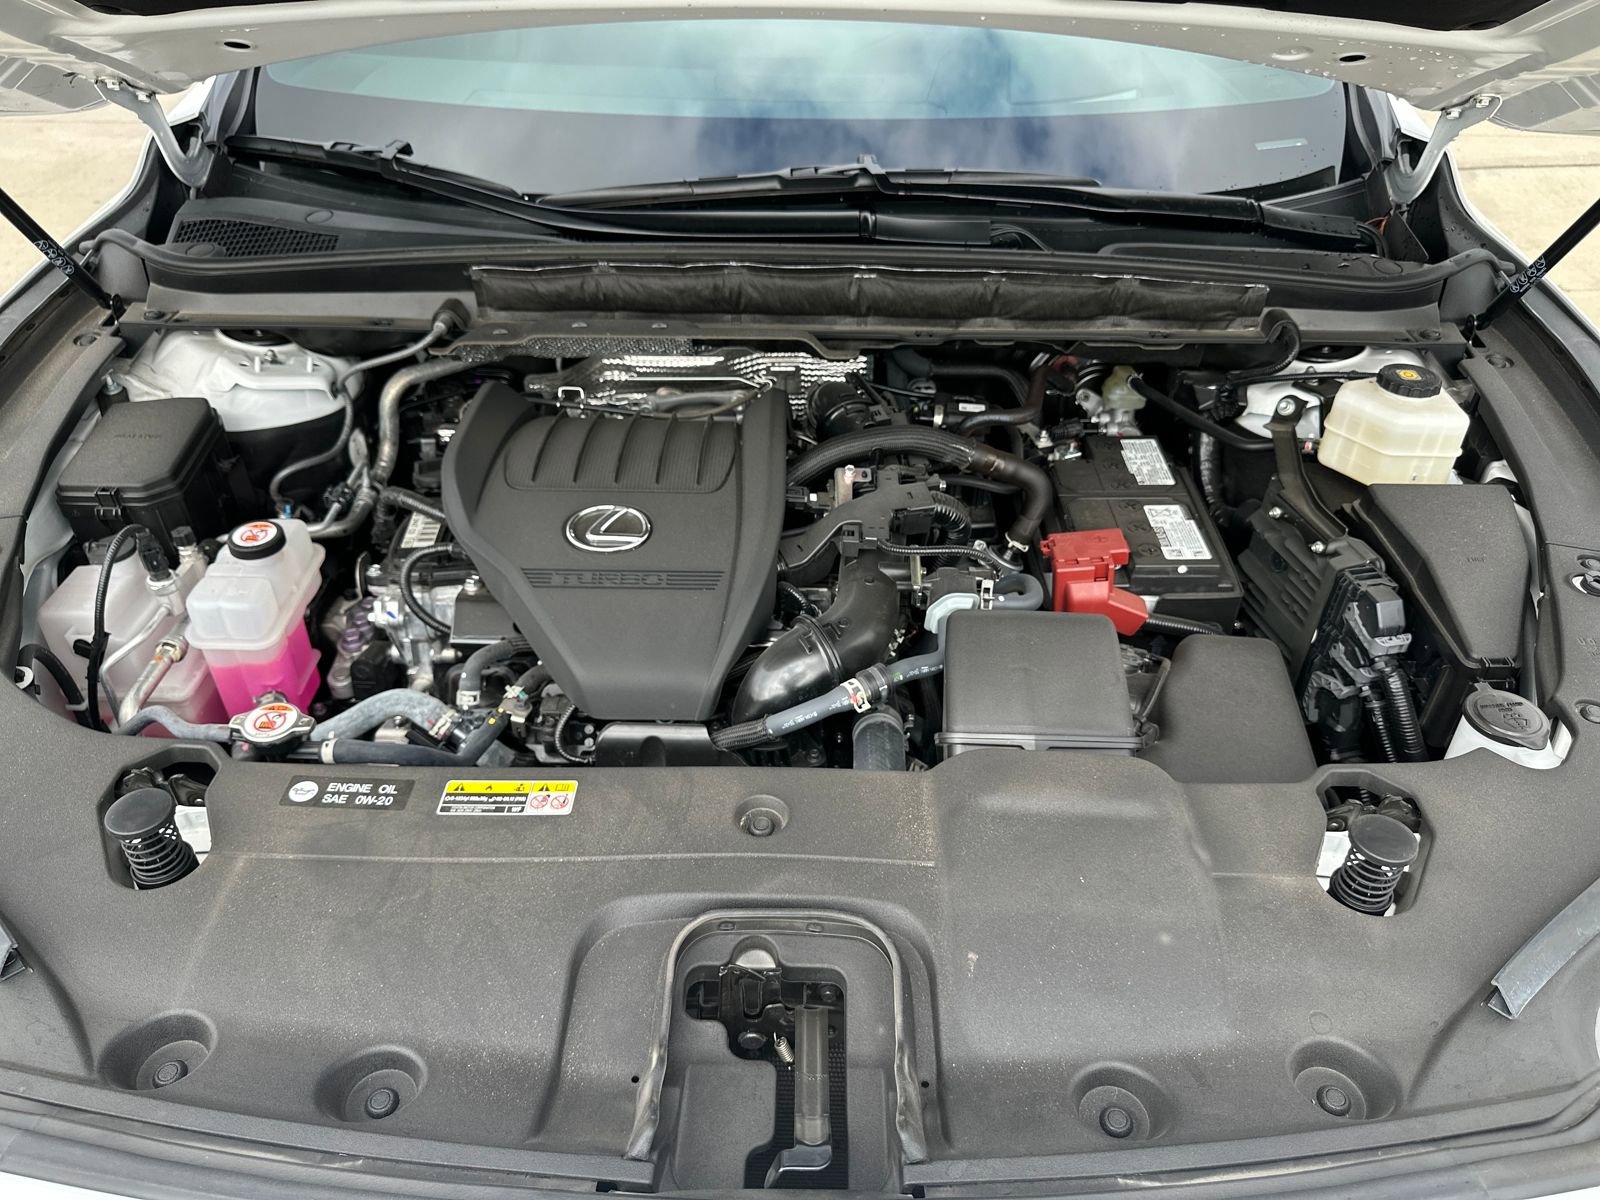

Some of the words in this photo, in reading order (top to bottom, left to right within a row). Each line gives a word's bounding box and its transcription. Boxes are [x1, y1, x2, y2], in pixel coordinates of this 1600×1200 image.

[556, 572, 664, 585] TURBO
[326, 782, 373, 793] ENGINE
[378, 784, 398, 795] OIL
[321, 793, 349, 804] SAE
[354, 795, 394, 806] 0W-20
